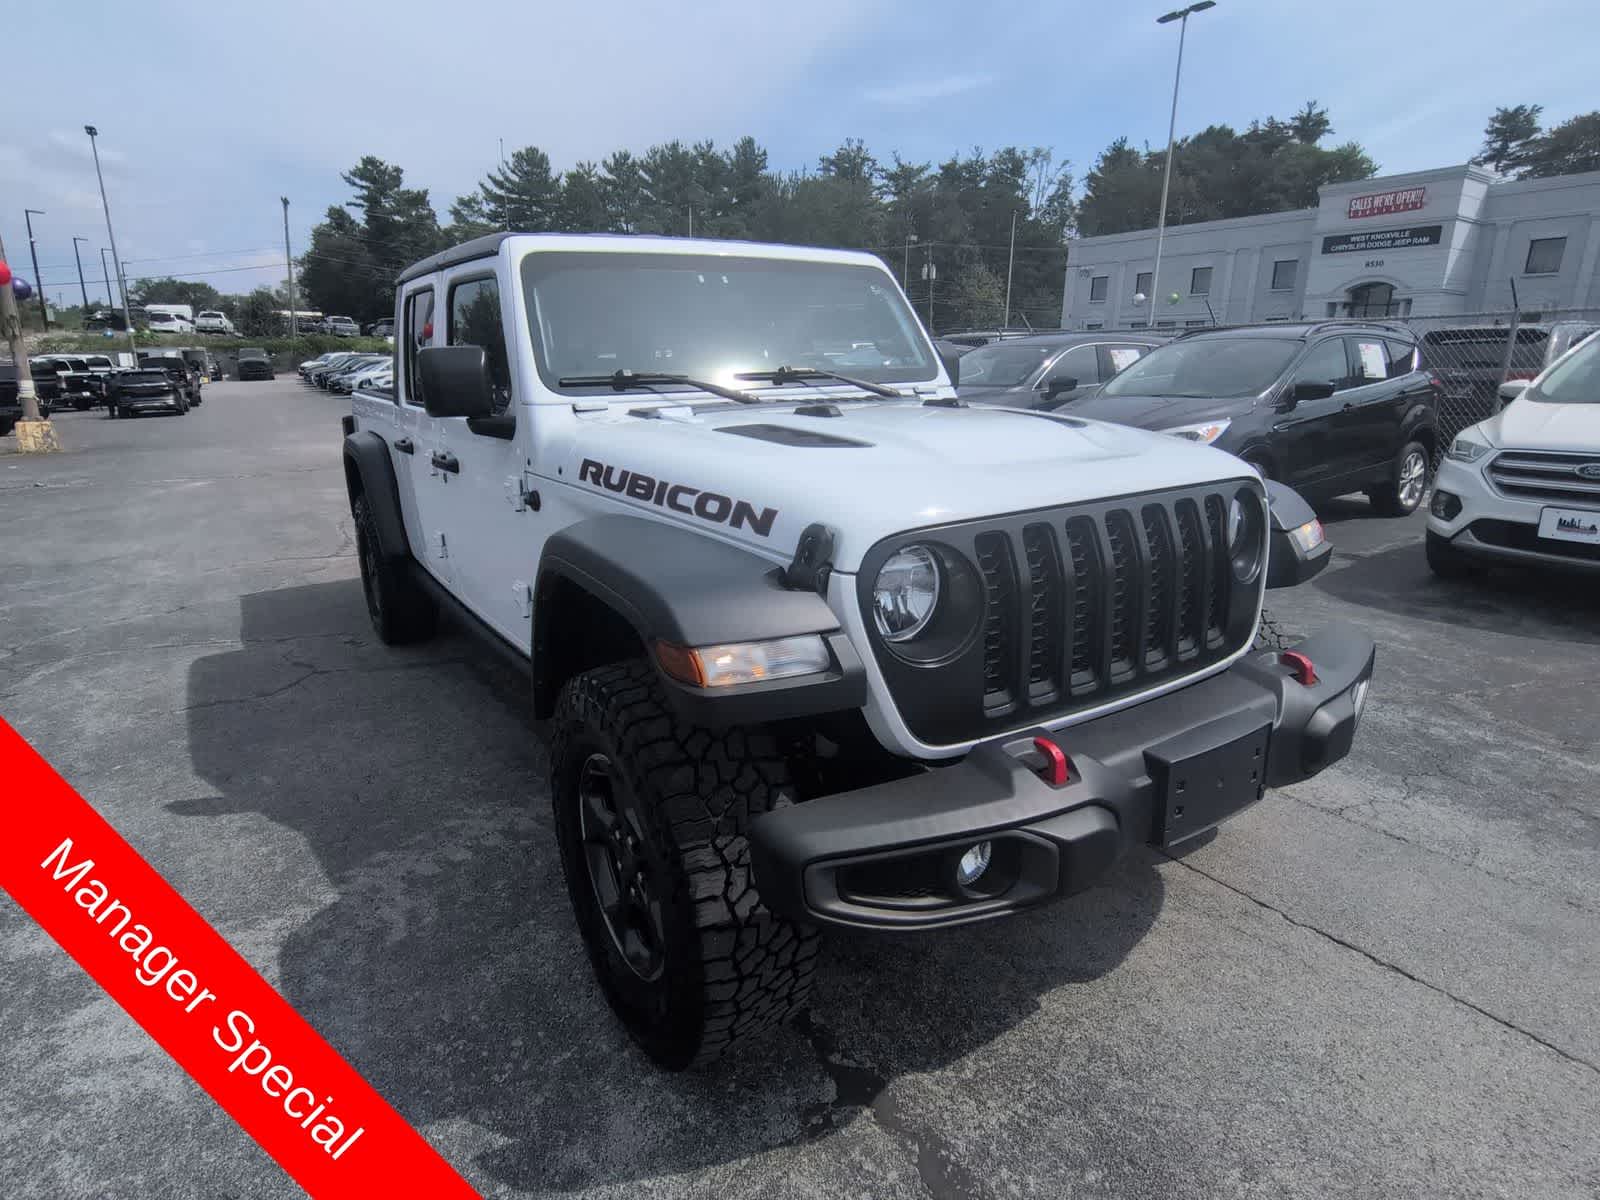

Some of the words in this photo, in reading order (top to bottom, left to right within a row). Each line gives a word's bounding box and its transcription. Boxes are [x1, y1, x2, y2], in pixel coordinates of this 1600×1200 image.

[1330, 242, 1366, 251] CHRYSLER
[1366, 239, 1392, 249] DODGE
[1392, 238, 1412, 247] JEEP
[1412, 236, 1430, 245] RAM
[1350, 233, 1370, 242] WEST
[1370, 231, 1410, 241] KNOXVILLE
[578, 458, 779, 537] RUBICON
